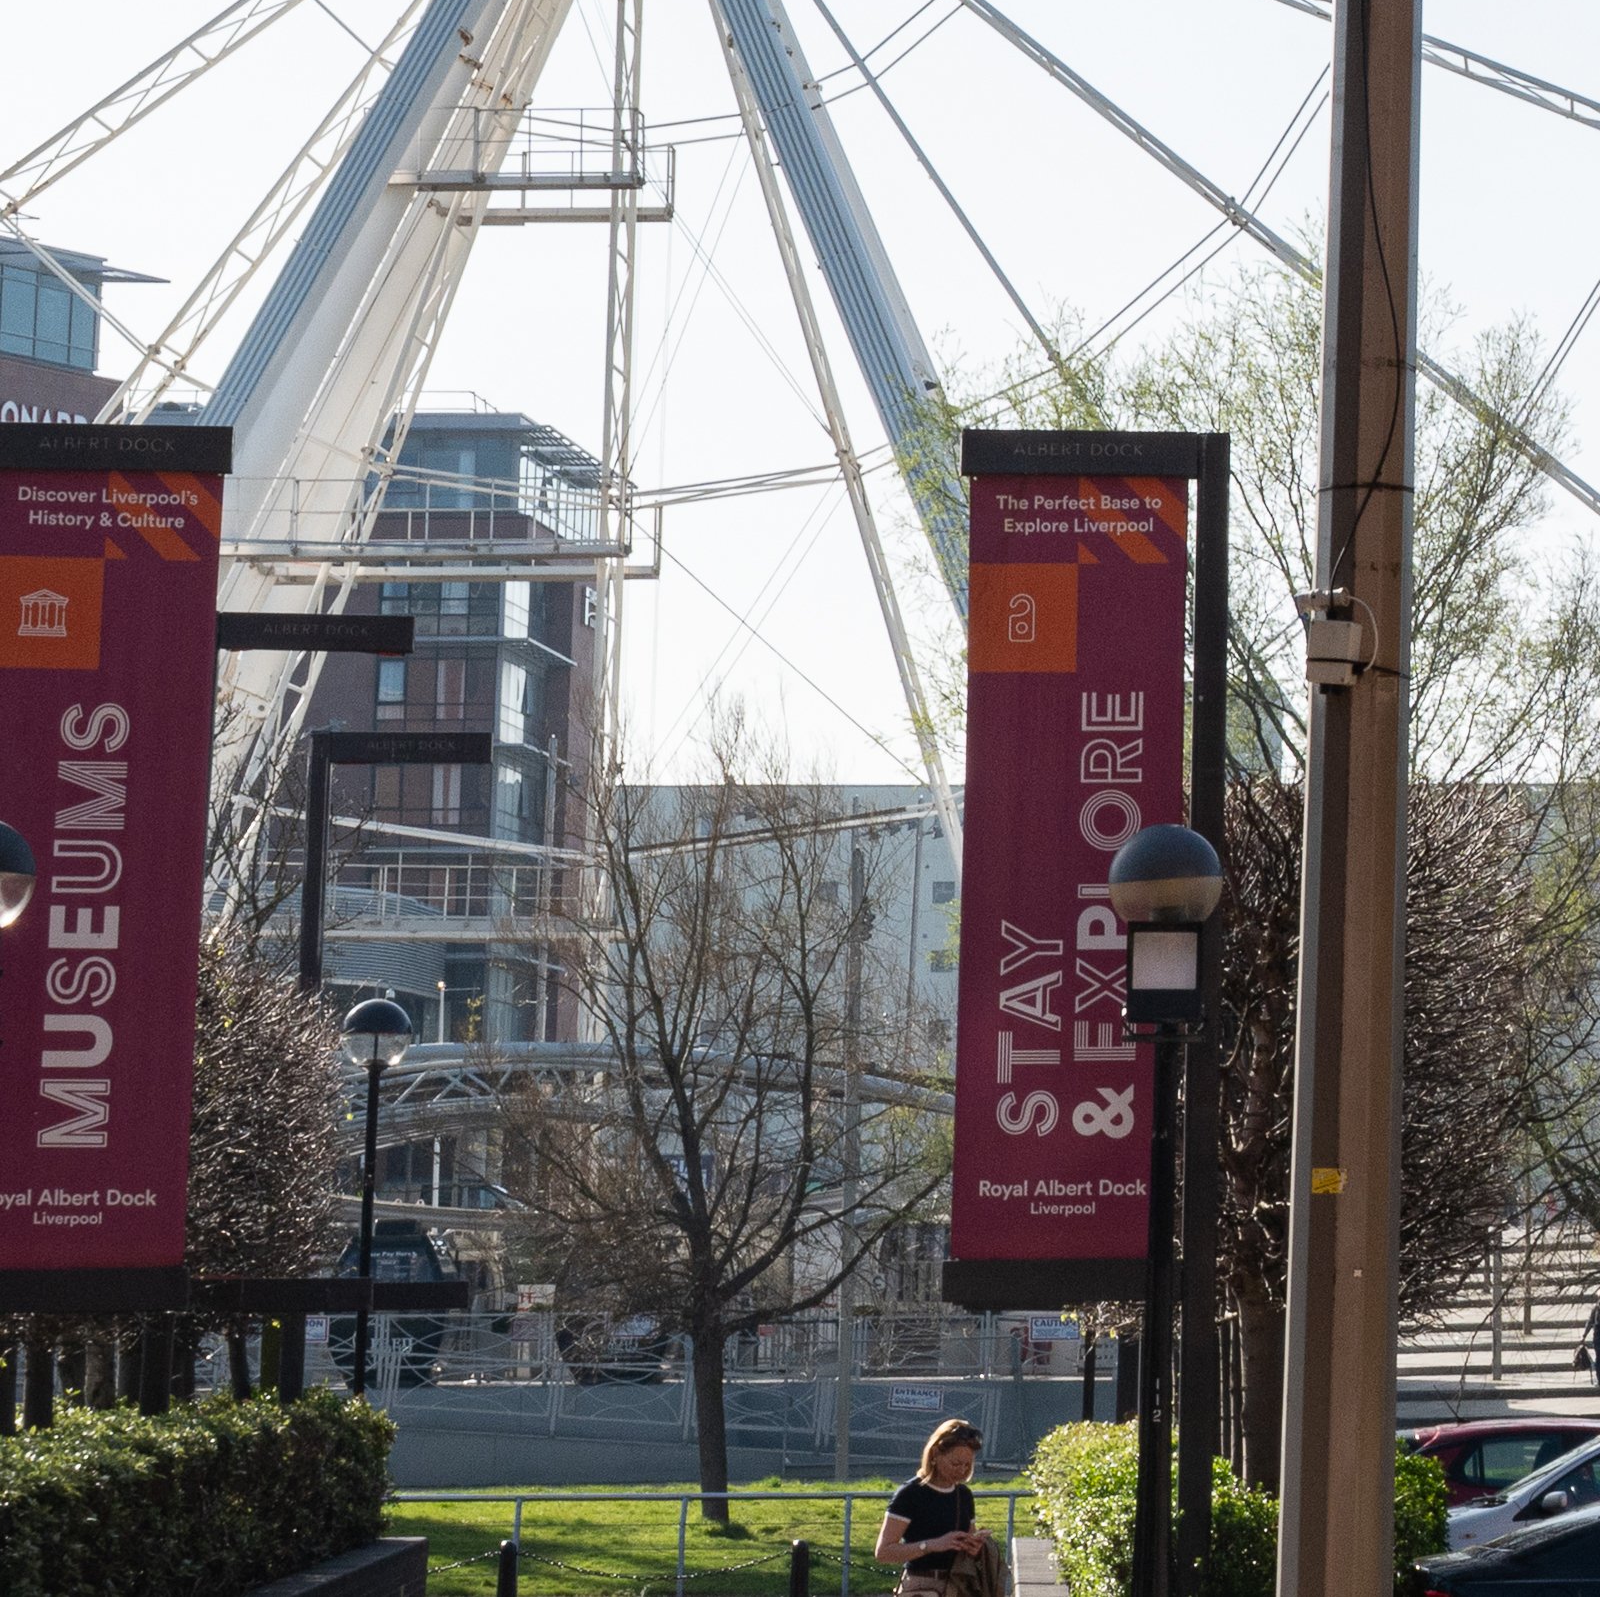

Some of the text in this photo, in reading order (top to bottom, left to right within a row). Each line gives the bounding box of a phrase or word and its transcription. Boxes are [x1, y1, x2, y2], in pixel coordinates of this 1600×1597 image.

[39, 436, 176, 452] ALBERT DOCK
[1013, 443, 1144, 457] ALBERT DOCK
[18, 486, 198, 507] Discover Liverpool's
[996, 495, 1162, 510] The Perfect Base to
[29, 510, 185, 530] History & Culture
[1004, 518, 1154, 536] Explore Liverpool
[36, 703, 130, 1148] MUSEUMS
[996, 920, 1063, 1137] STAY
[1072, 1083, 1135, 1140] &
[0, 1189, 157, 1210] yal Albert Dock
[979, 1179, 1147, 1202] Royal Albert Dock
[33, 1211, 103, 1227] Liverpool
[1030, 1201, 1096, 1217] Liverpool
